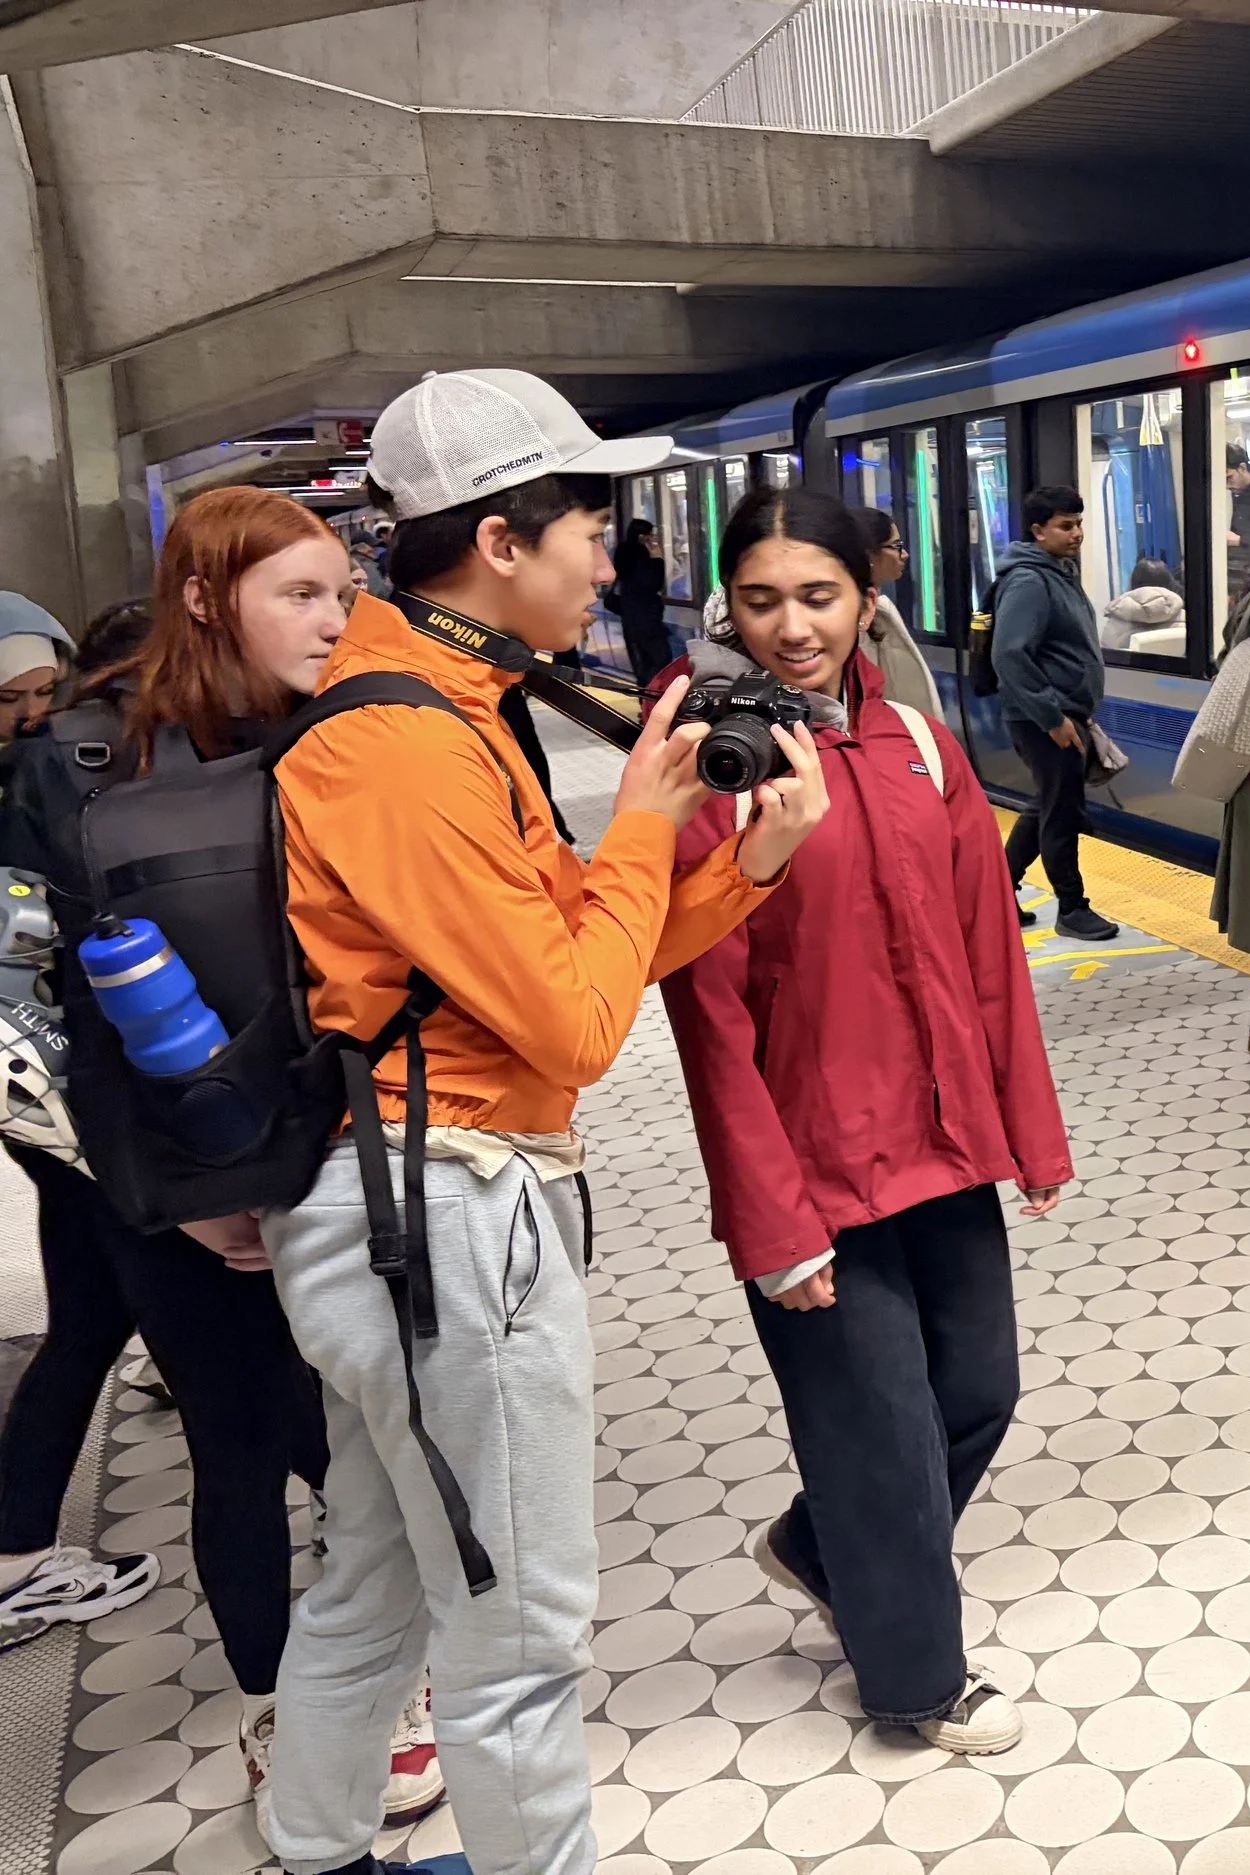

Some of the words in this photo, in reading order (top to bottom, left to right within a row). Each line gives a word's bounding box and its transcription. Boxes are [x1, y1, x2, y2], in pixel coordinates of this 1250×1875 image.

[472, 451, 543, 487] CROTCHEDMTN
[427, 612, 488, 649] Nikon
[731, 697, 756, 706] Nikon
